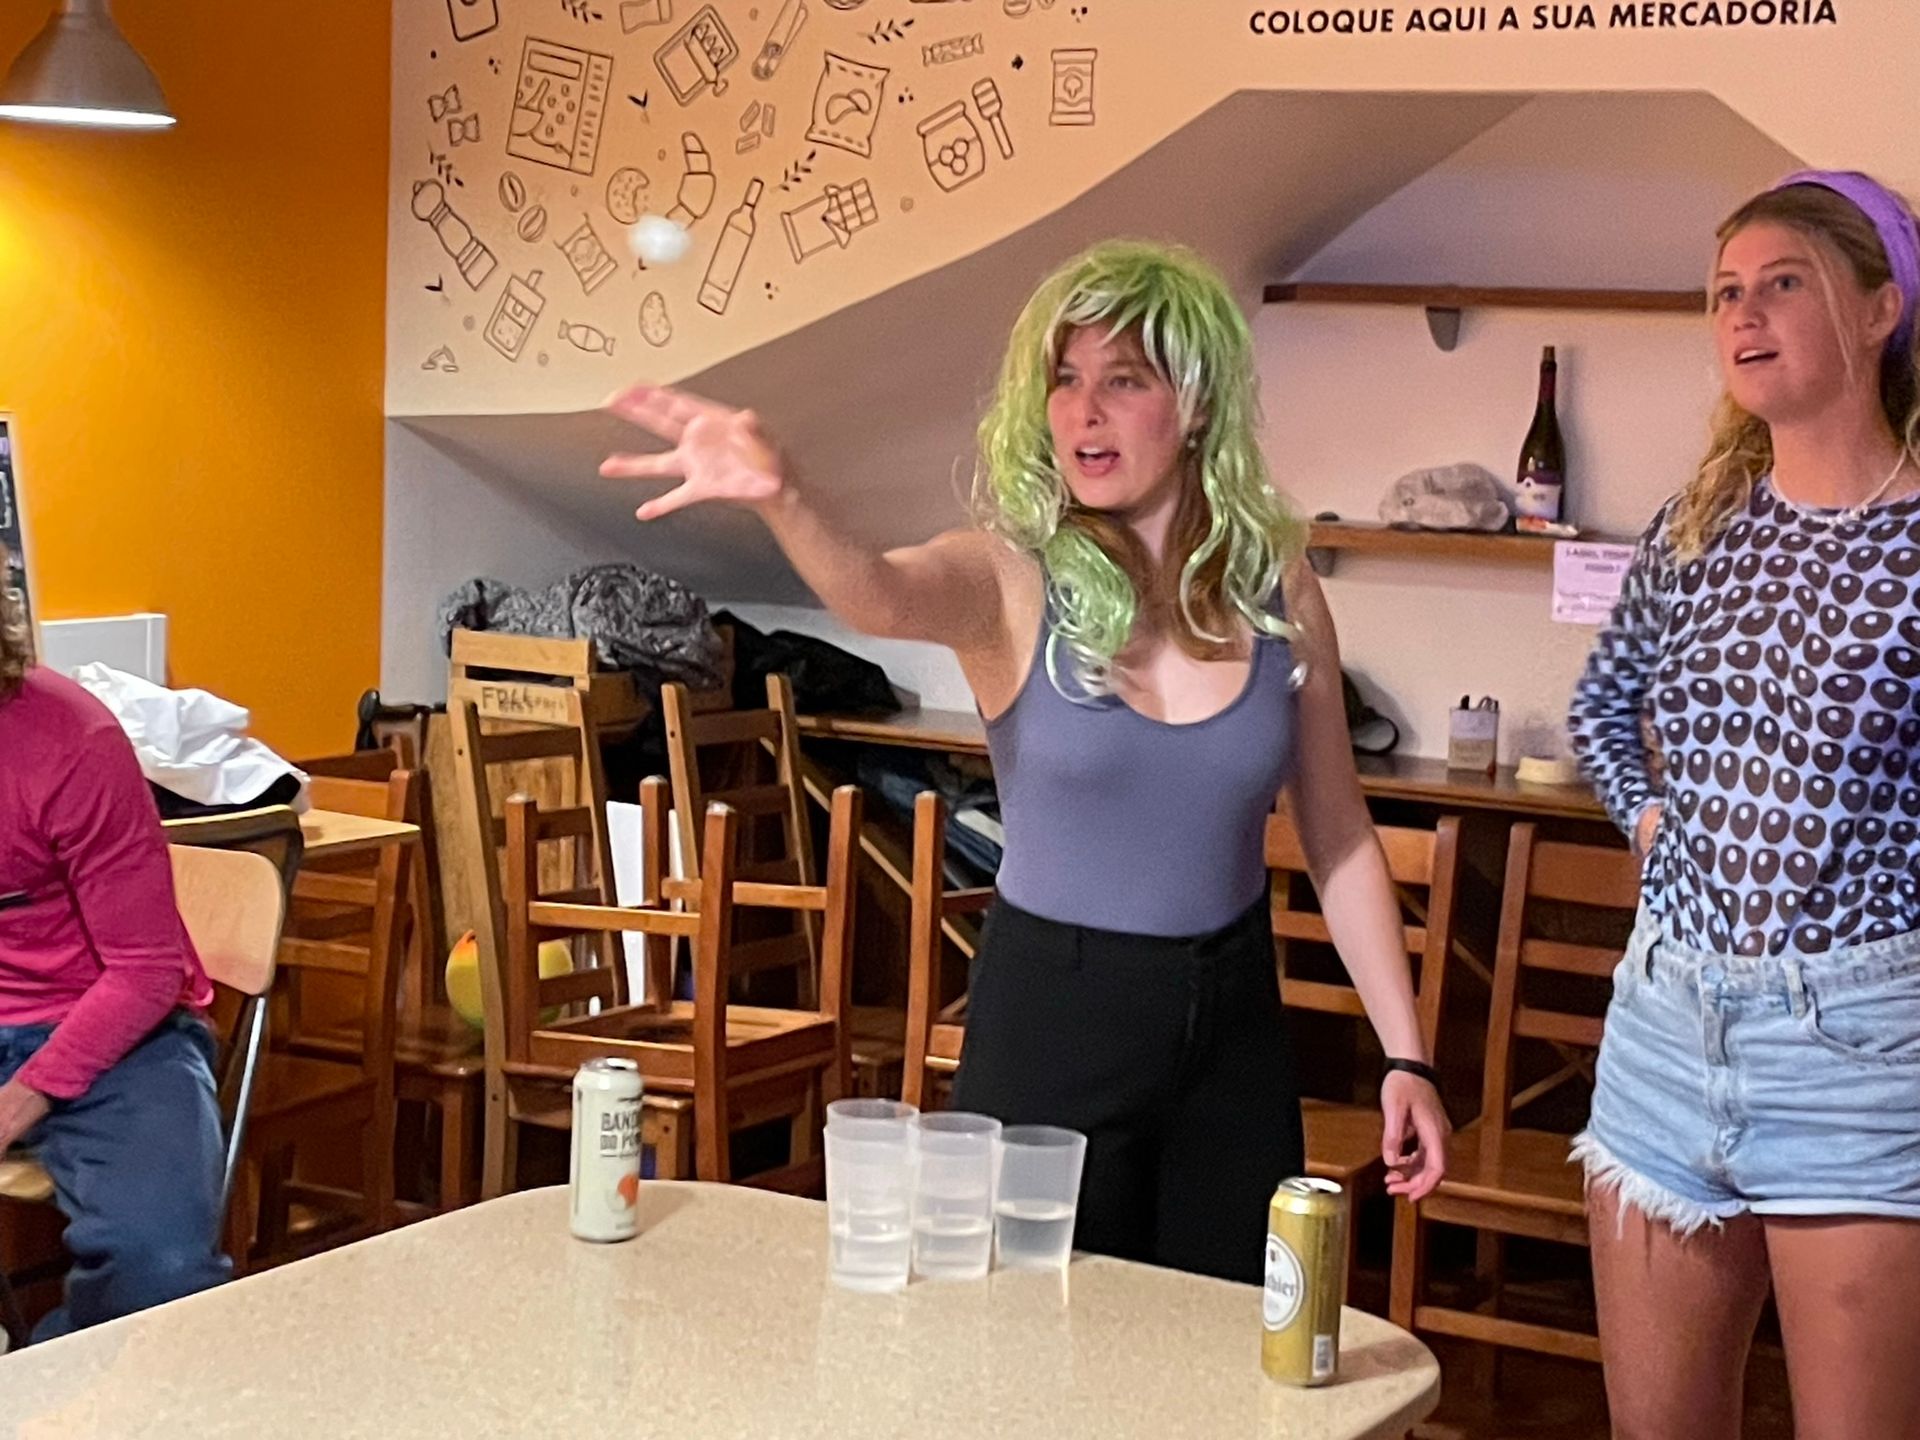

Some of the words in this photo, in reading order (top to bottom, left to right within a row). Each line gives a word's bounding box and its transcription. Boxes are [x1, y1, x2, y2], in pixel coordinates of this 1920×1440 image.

[1250, 9, 1394, 34] COLOQUE
[1405, 7, 1486, 32] AQUI
[1498, 7, 1519, 31] A
[1532, 4, 1596, 30] SUA
[1609, 0, 1837, 28] MERCADORIA
